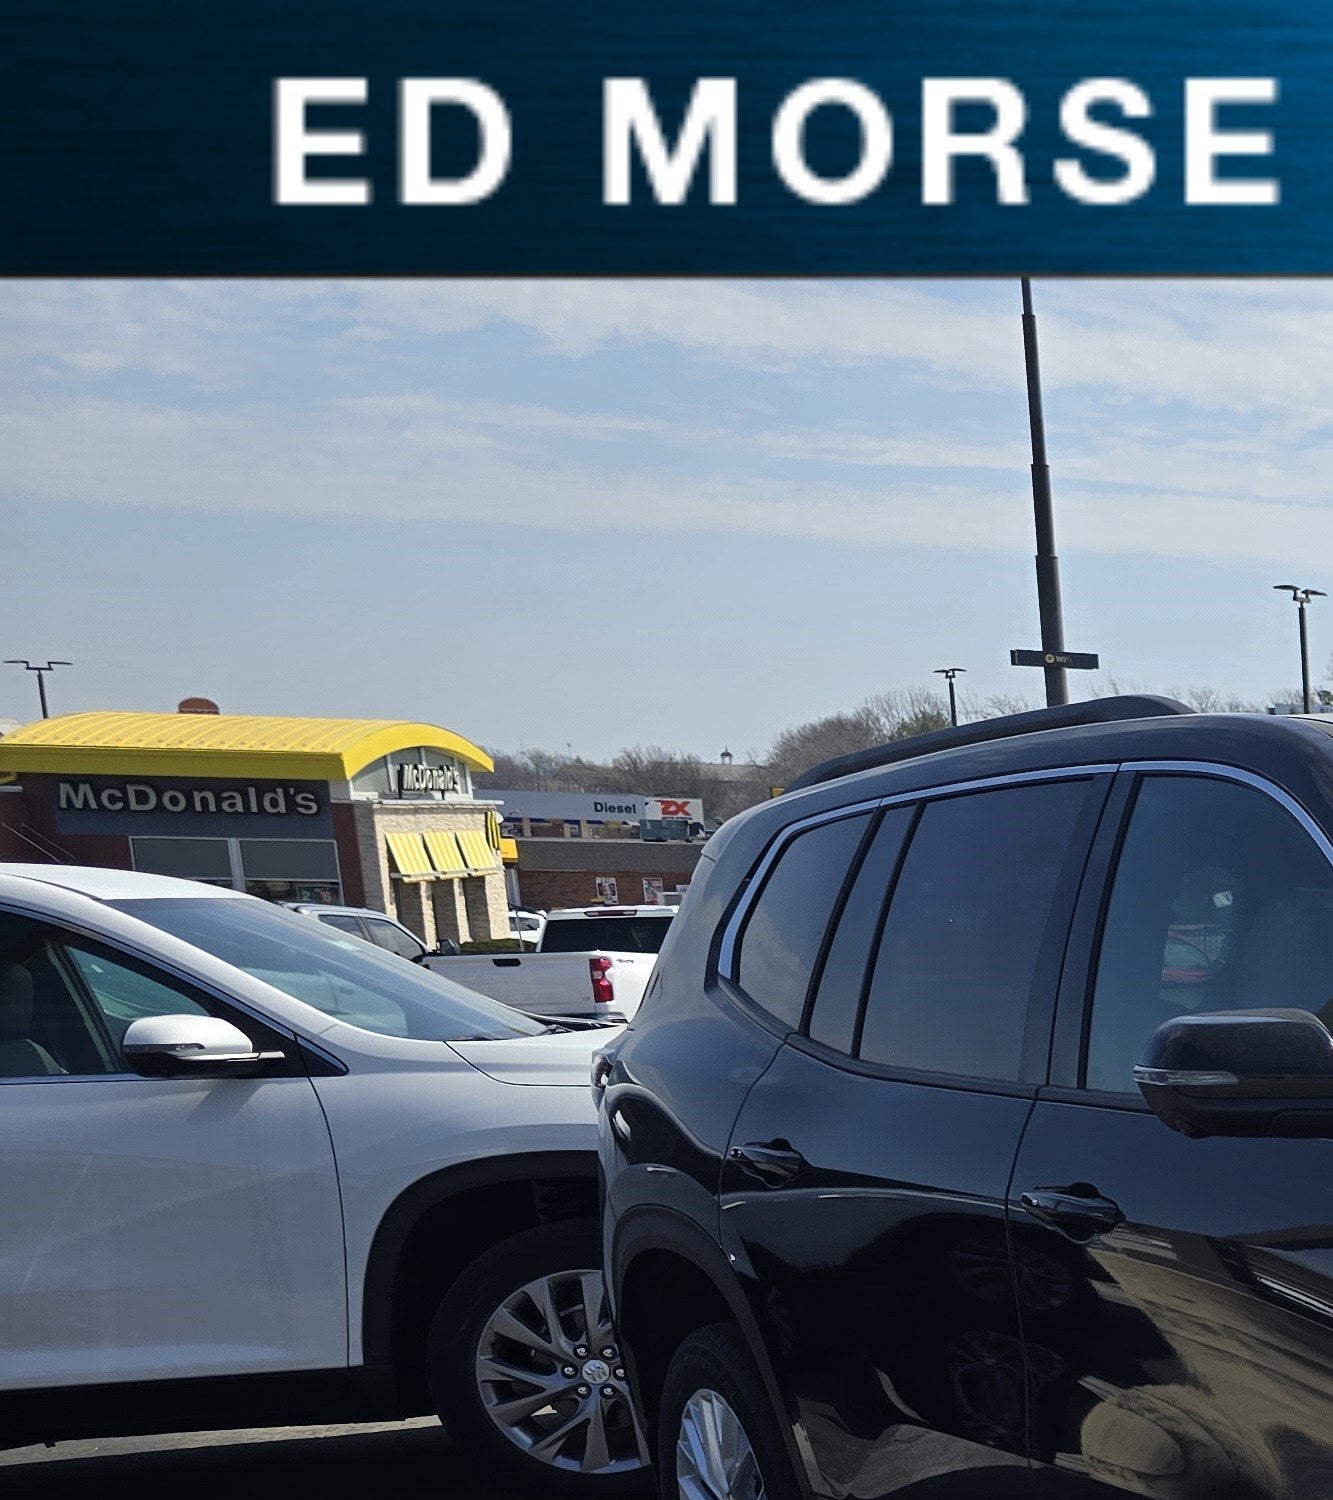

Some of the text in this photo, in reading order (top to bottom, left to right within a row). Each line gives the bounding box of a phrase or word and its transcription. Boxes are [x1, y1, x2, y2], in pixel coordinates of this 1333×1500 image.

[402, 763, 461, 794] McDonald's
[59, 781, 319, 816] McDonald's
[594, 801, 636, 814] Diesel
